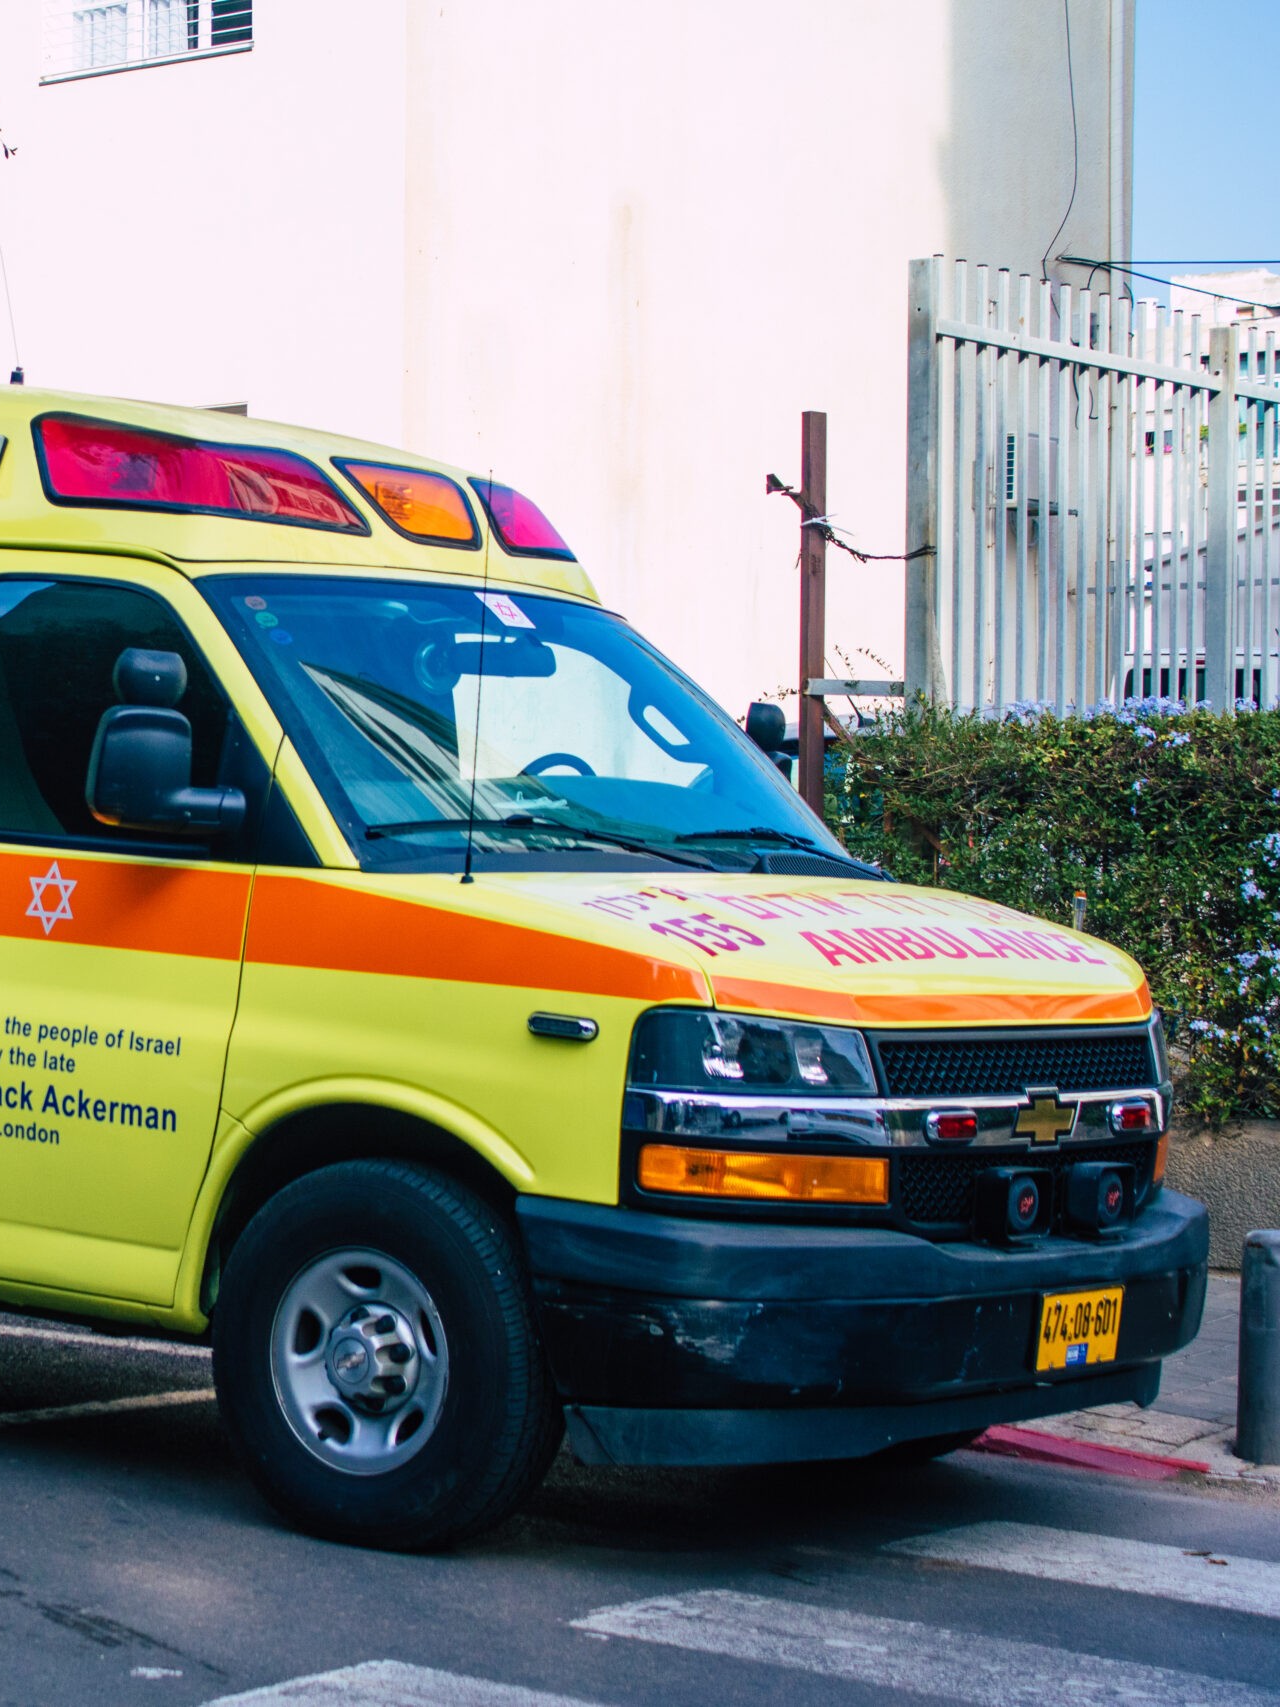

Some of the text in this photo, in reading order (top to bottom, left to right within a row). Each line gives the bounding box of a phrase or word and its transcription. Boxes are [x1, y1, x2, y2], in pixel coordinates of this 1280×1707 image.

[649, 912, 766, 957] 155
[798, 926, 1107, 966] AMBULANCE
[5, 1016, 32, 1037] the
[38, 1024, 99, 1048] people
[105, 1029, 125, 1049] of
[129, 1031, 182, 1057] Israel
[9, 1047, 37, 1068] the
[43, 1051, 76, 1073] late
[41, 1084, 177, 1132] Ackerman
